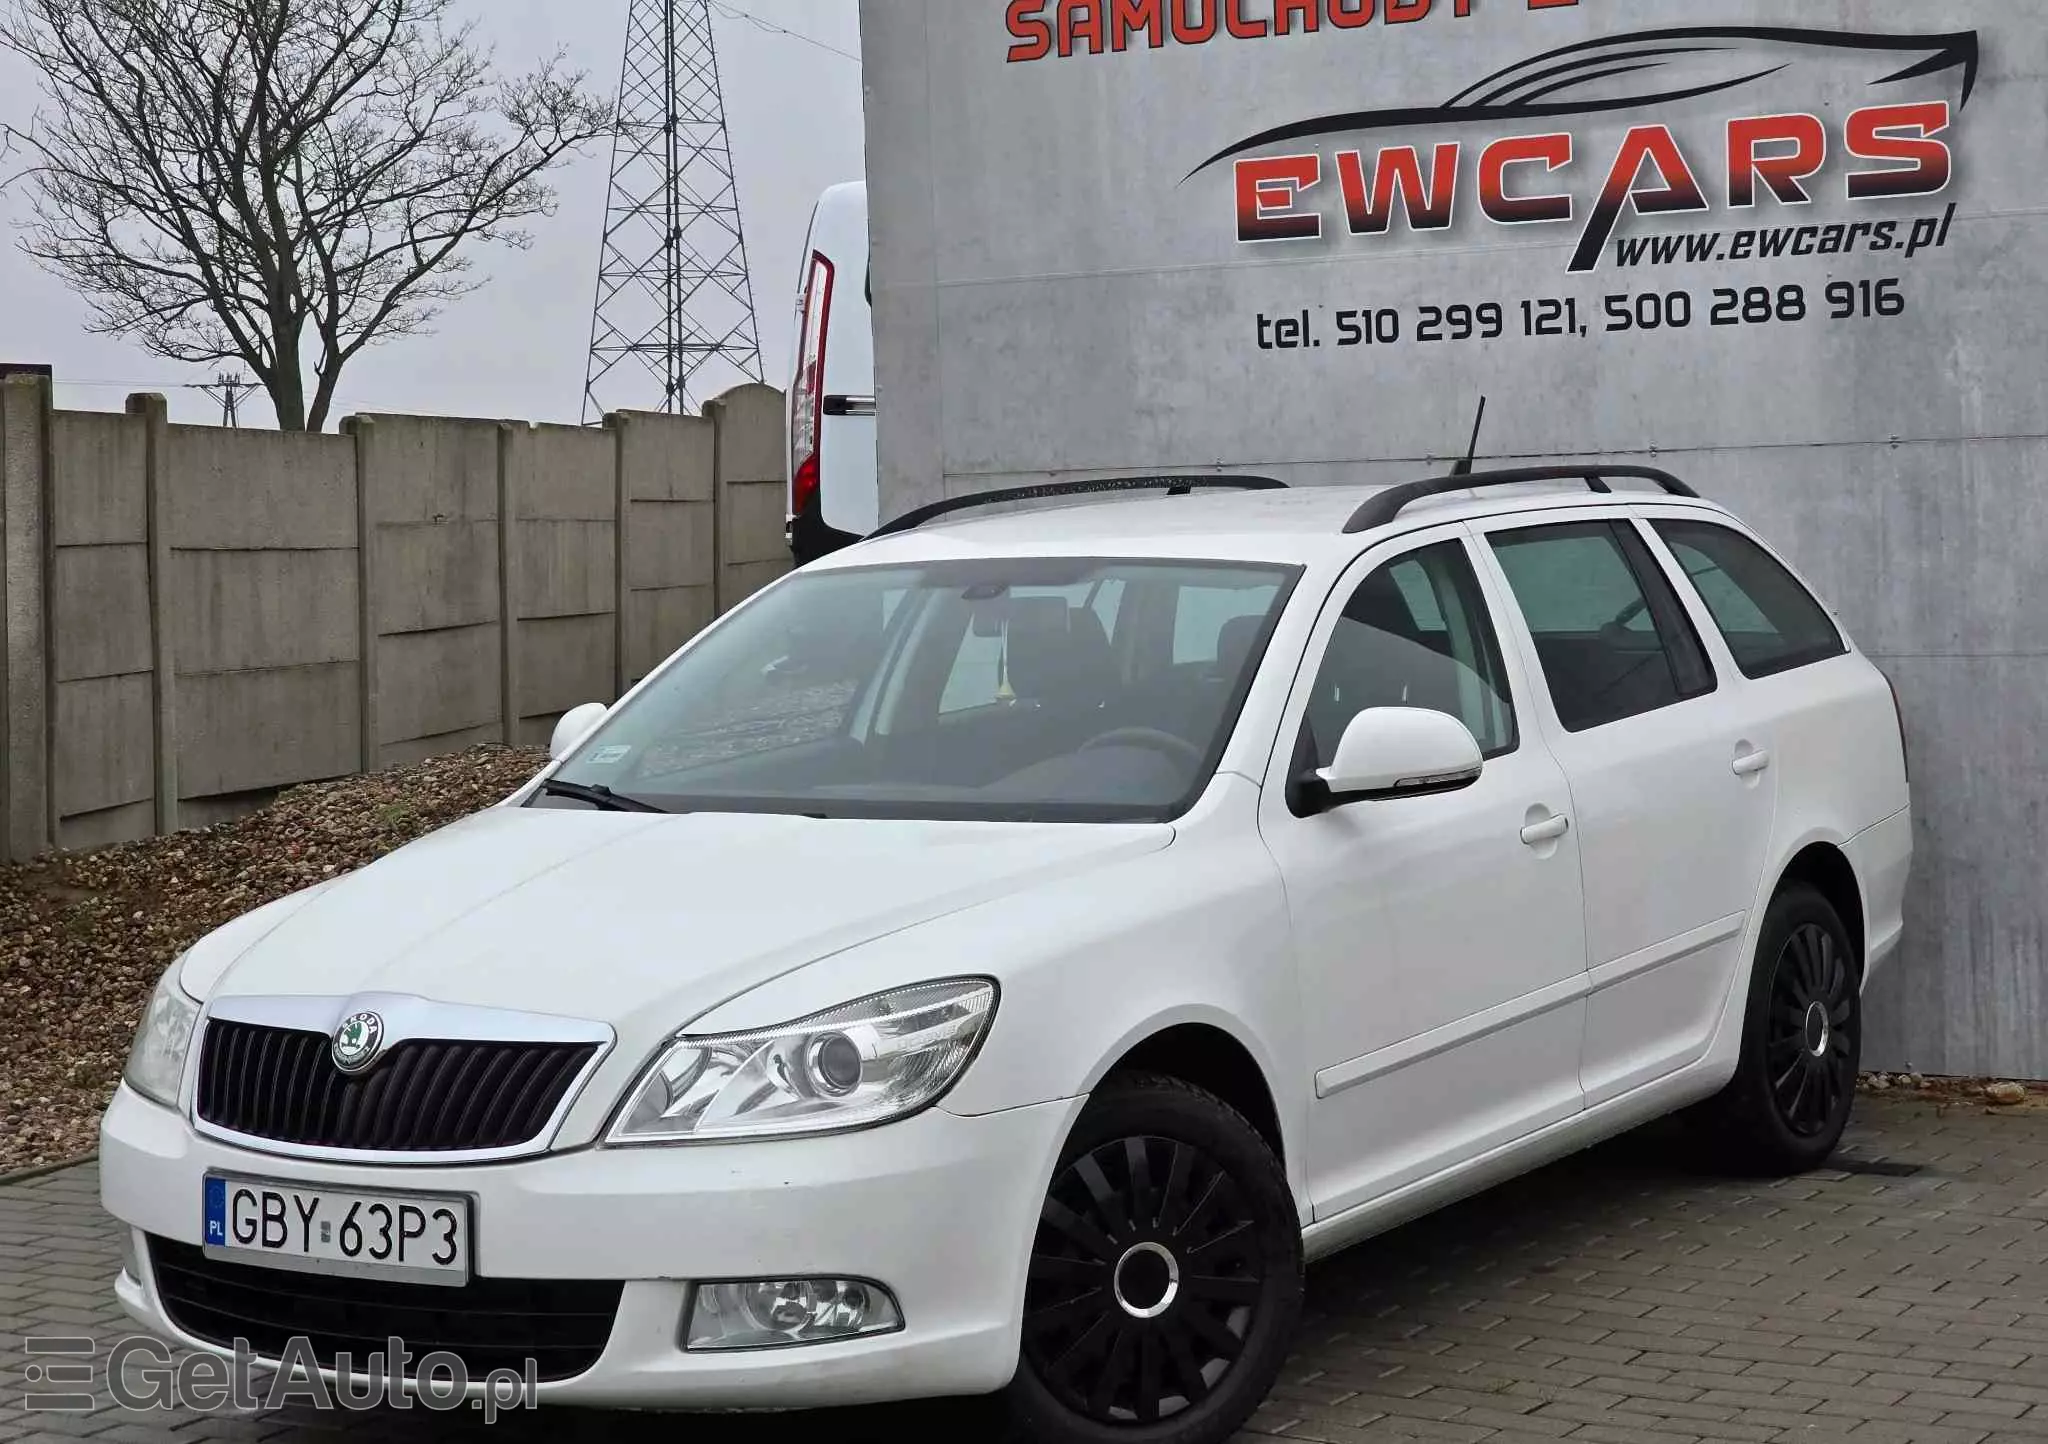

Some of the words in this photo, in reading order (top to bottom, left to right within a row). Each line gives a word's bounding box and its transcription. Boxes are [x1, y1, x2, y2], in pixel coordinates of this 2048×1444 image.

[1006, 0, 1471, 63] SAMOCH
[1234, 100, 1951, 273] EWCARS
[1616, 203, 1956, 267] www.ewcars.pl
[1257, 309, 1320, 349] tel.
[1336, 308, 1399, 346] 510
[1416, 303, 1502, 341] 299
[1521, 297, 1587, 337] 121,
[1604, 291, 1691, 331] 500
[1710, 285, 1806, 325] 288
[1825, 278, 1904, 318] 916
[209, 1220, 223, 1237] PL
[232, 1188, 320, 1252] GBY
[339, 1201, 458, 1266] 63P3
